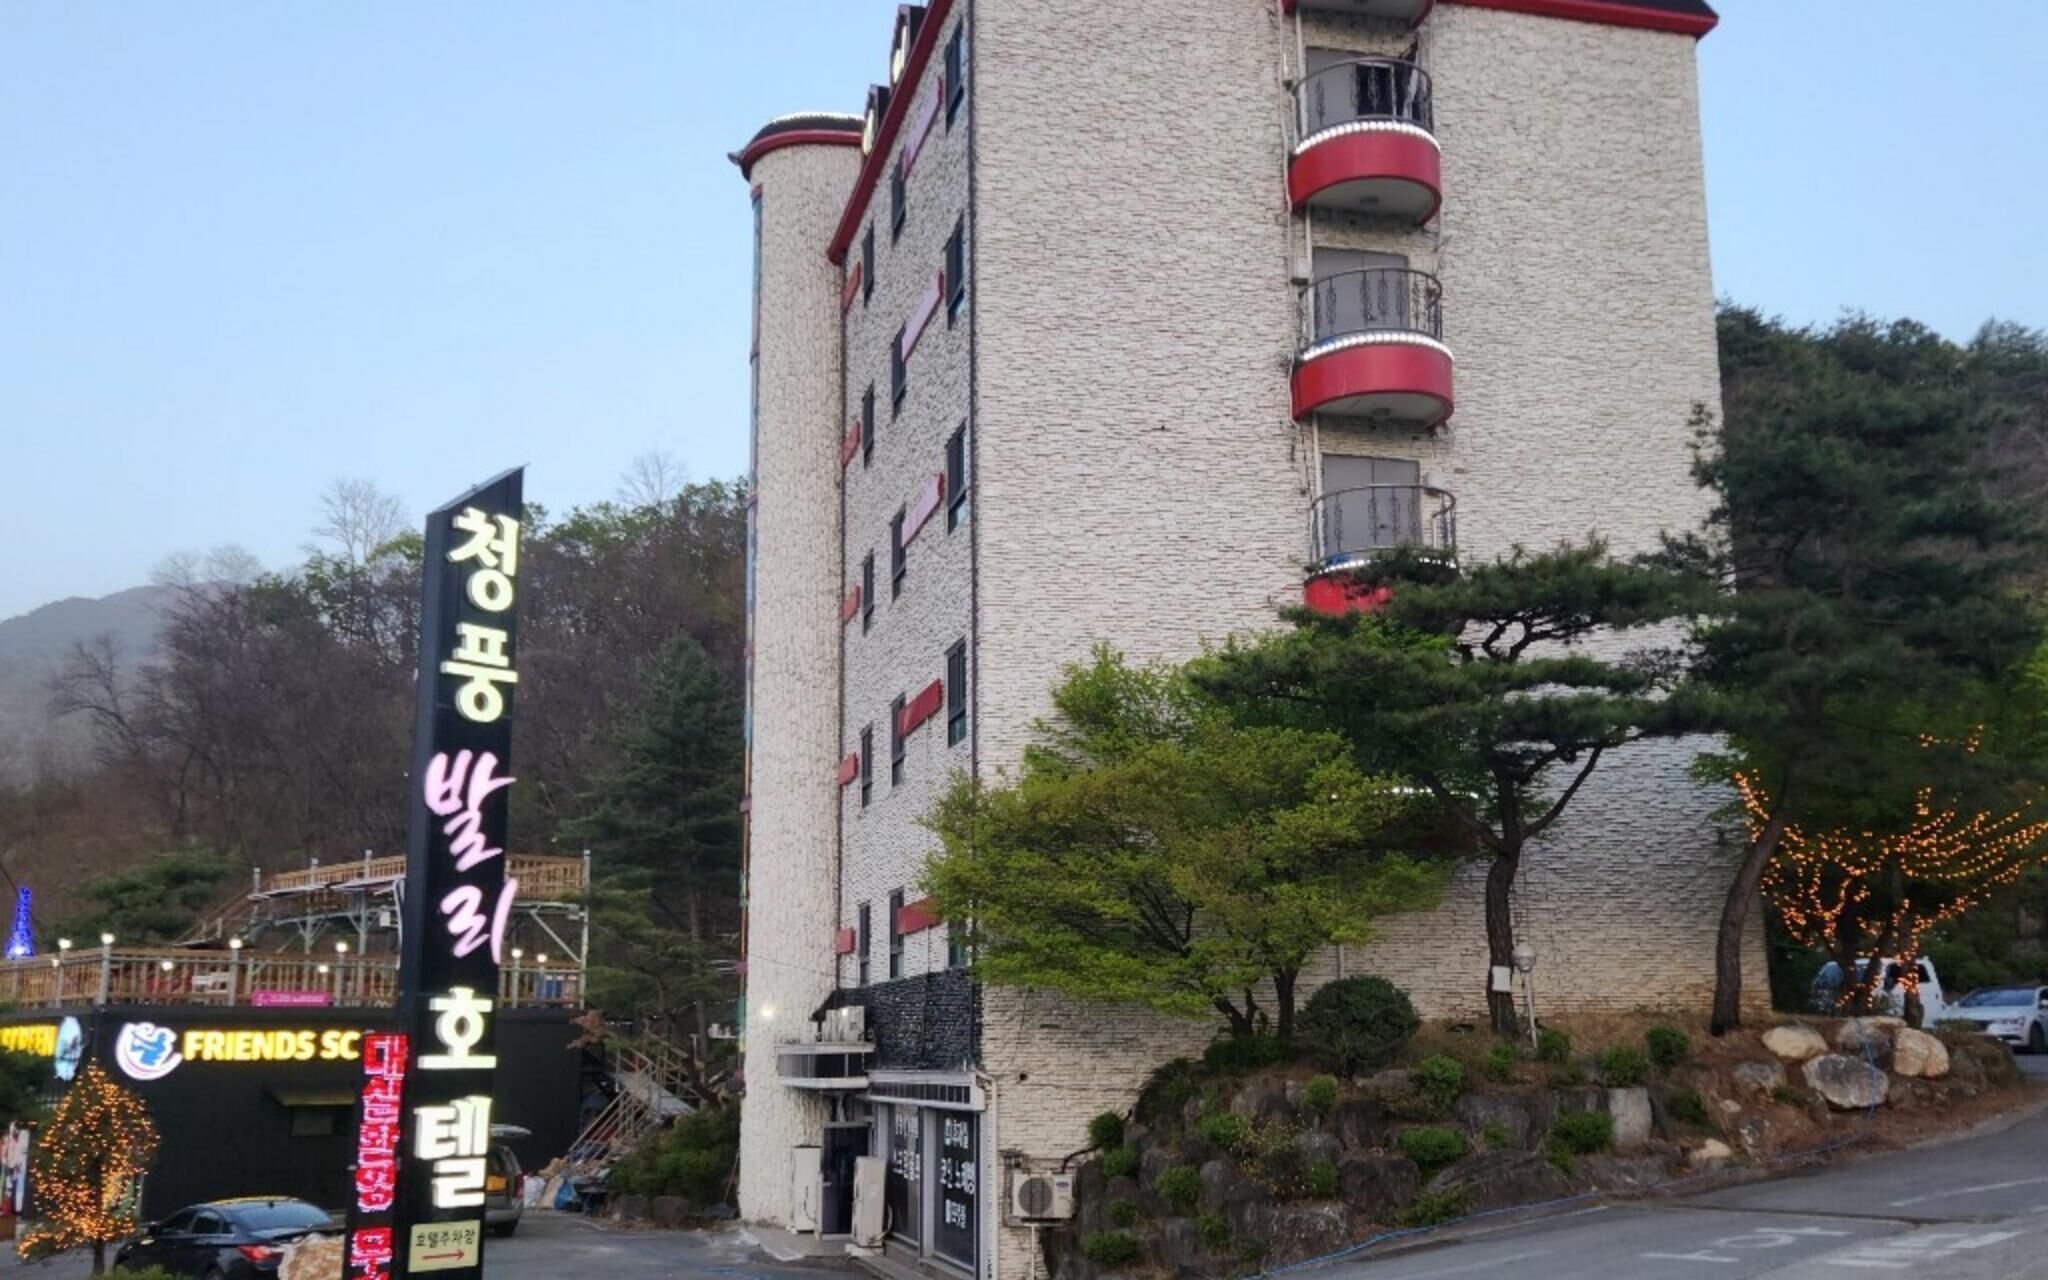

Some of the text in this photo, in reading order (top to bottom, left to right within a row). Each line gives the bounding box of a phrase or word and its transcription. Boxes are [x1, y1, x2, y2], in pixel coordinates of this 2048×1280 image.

[414, 506, 519, 1209] 청풍 발리 호텔
[184, 1030, 317, 1061] FRIENDS
